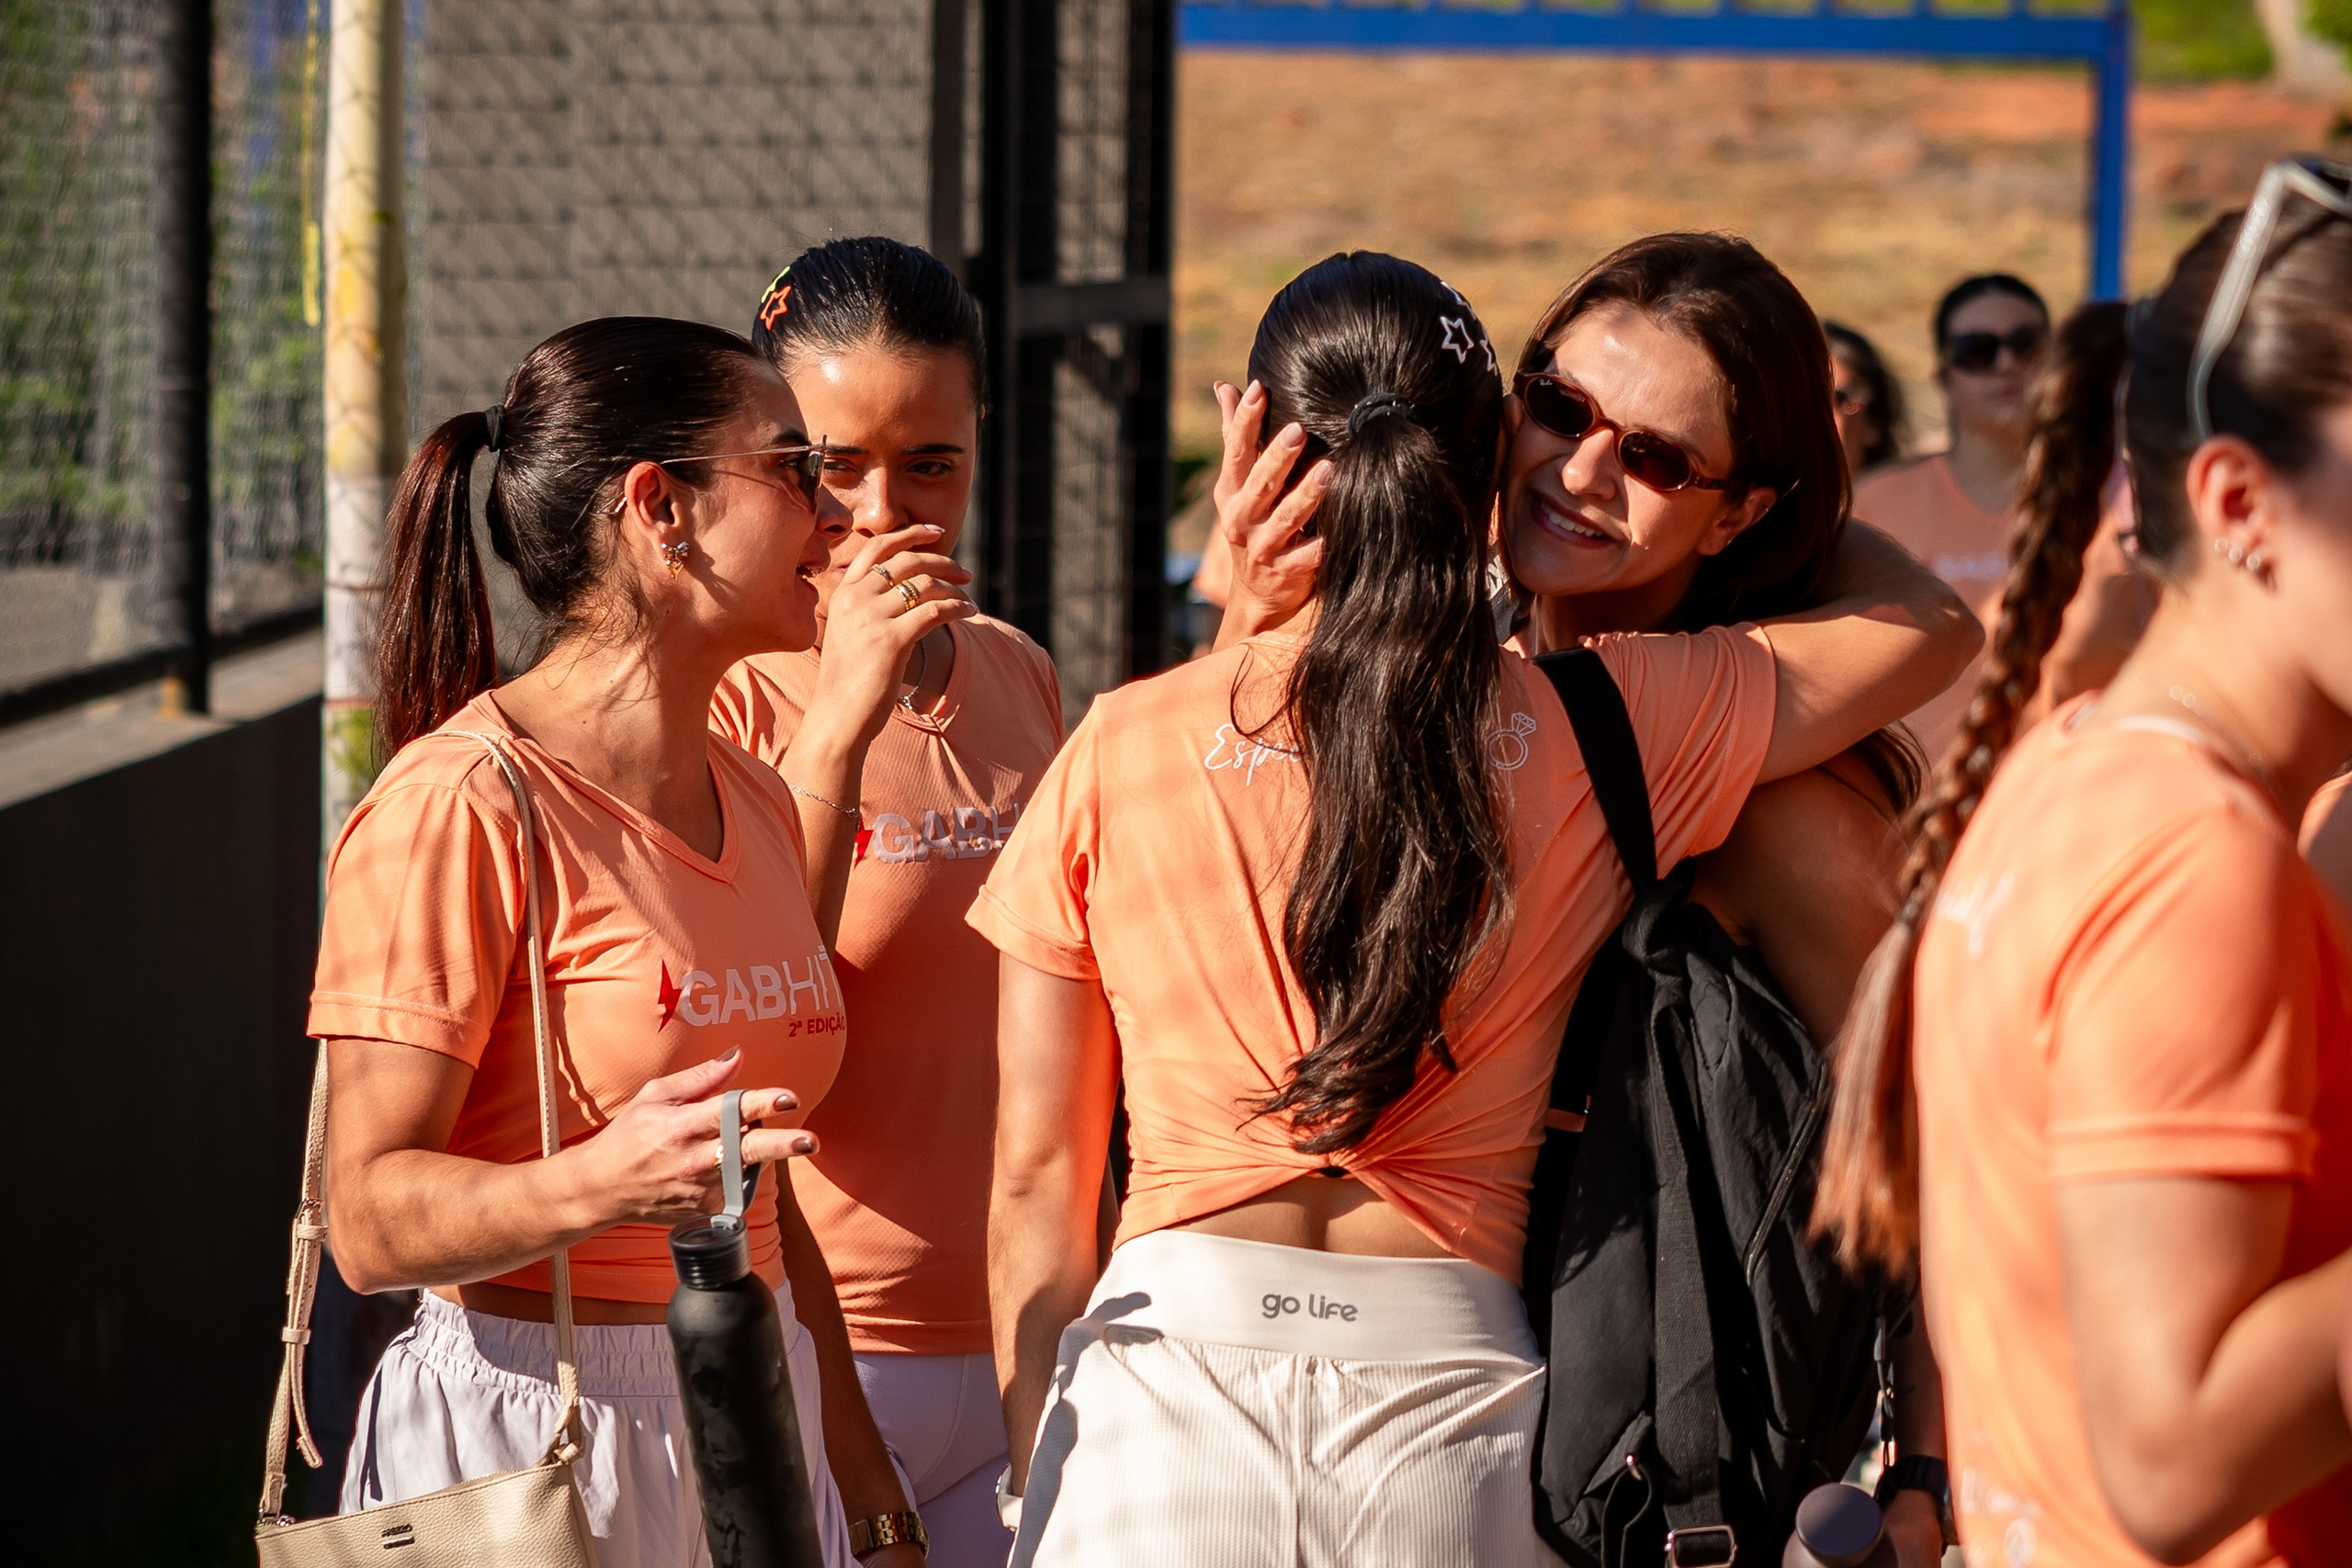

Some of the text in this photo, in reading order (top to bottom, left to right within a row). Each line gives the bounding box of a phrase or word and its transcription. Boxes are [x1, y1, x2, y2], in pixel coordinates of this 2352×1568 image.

[872, 802, 1027, 863] GABH
[1261, 1293, 1358, 1322] go life
